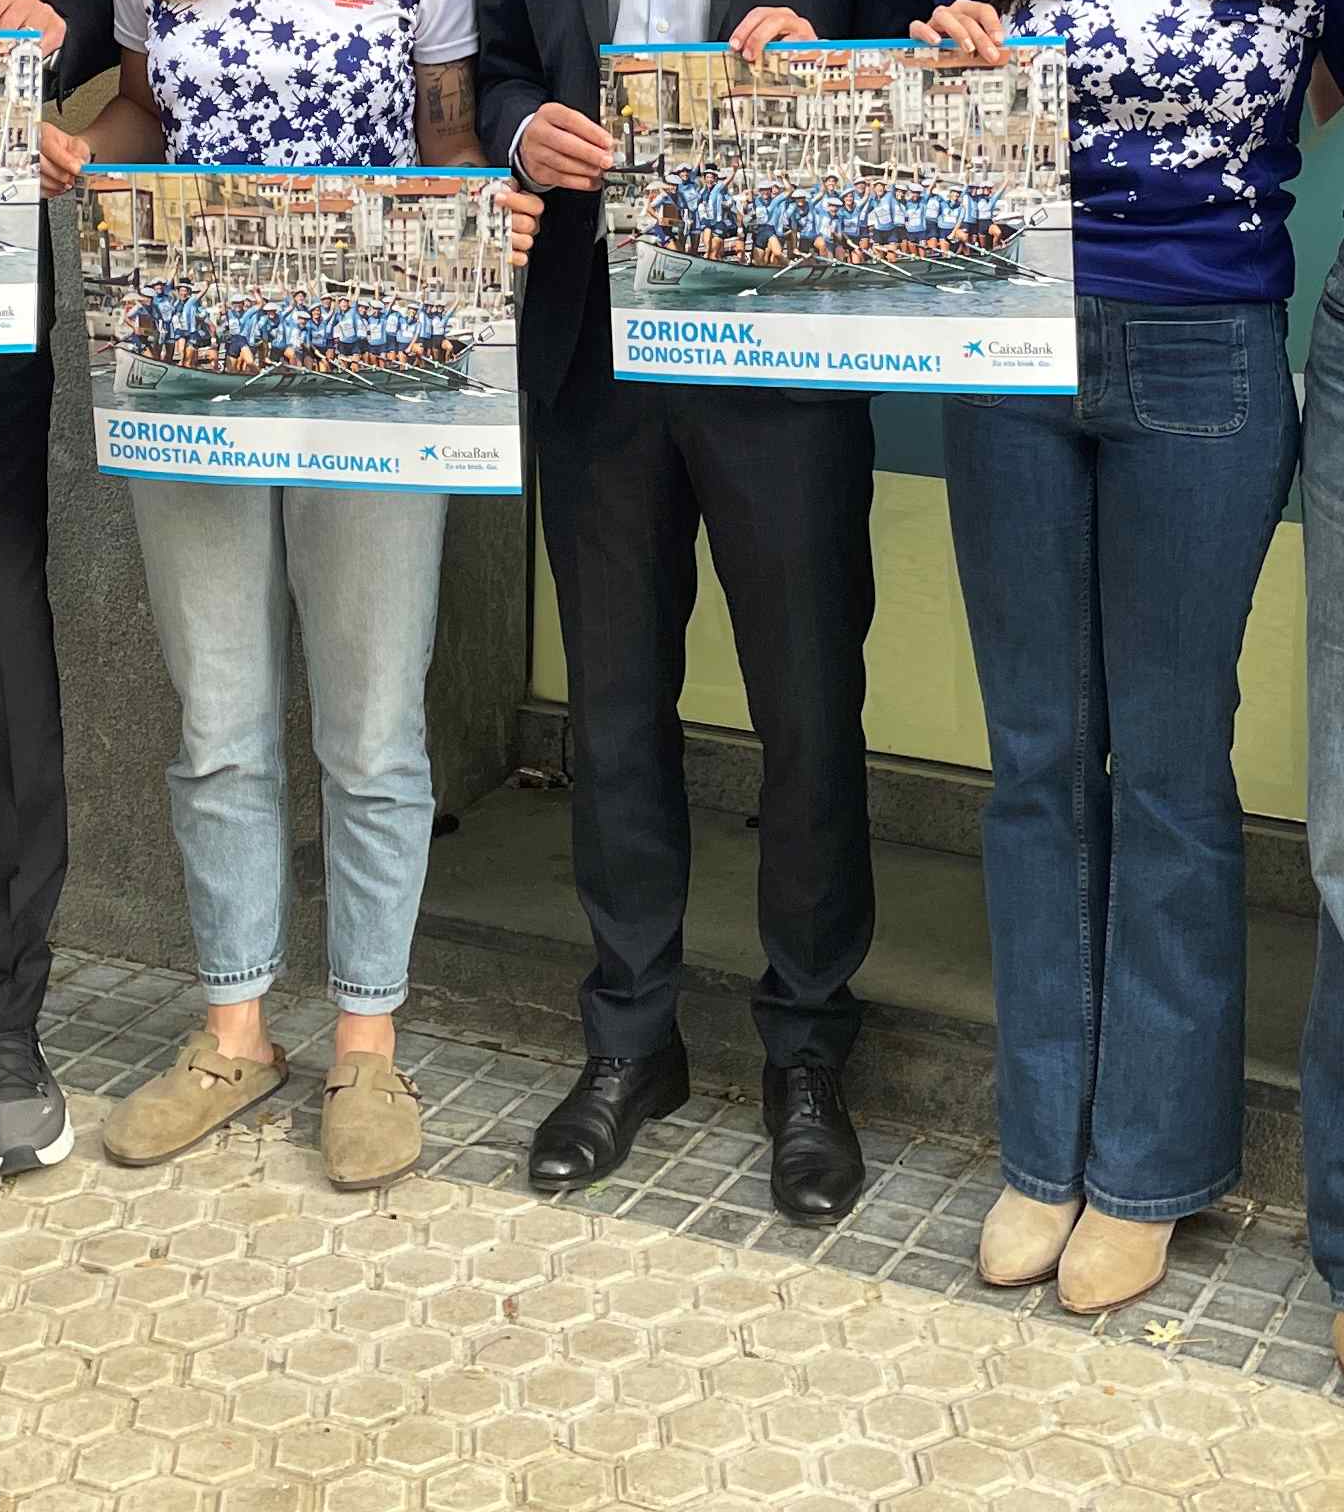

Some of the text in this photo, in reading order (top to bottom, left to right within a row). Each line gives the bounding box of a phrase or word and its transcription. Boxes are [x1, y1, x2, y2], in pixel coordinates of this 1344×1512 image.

[627, 320, 762, 345] ZORIONAK,
[629, 344, 940, 372] DONOSTIA ARRAUN LAGUNAK!
[988, 341, 1053, 355] CaixaBank
[109, 420, 233, 447] ZORIONAK,
[112, 442, 400, 472] DONOSTIA ARRAUN LAGUNAK!
[441, 446, 499, 459] CaixaBank
